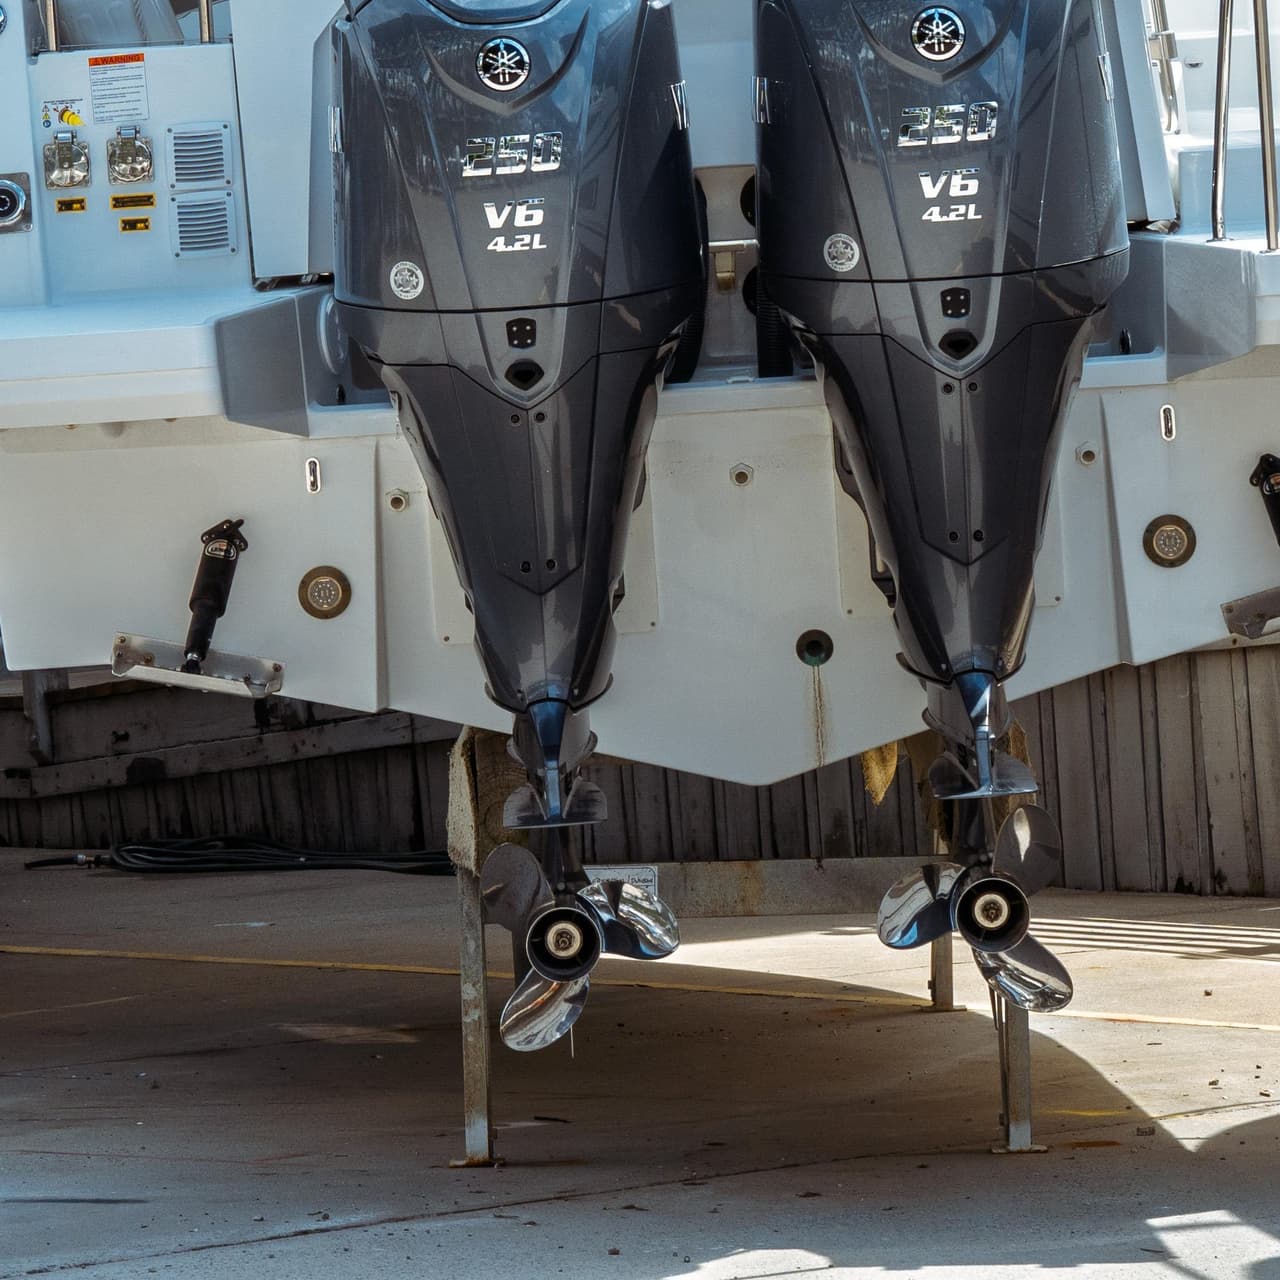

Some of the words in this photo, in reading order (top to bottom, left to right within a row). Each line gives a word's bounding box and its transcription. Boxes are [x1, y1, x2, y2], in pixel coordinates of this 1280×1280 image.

[101, 54, 140, 65] WARNING
[897, 101, 999, 147] 250
[462, 131, 563, 177] 250
[919, 168, 980, 198] V6
[483, 198, 544, 229] V6
[922, 203, 982, 222] 4.2L
[487, 233, 547, 252] 4.2L
